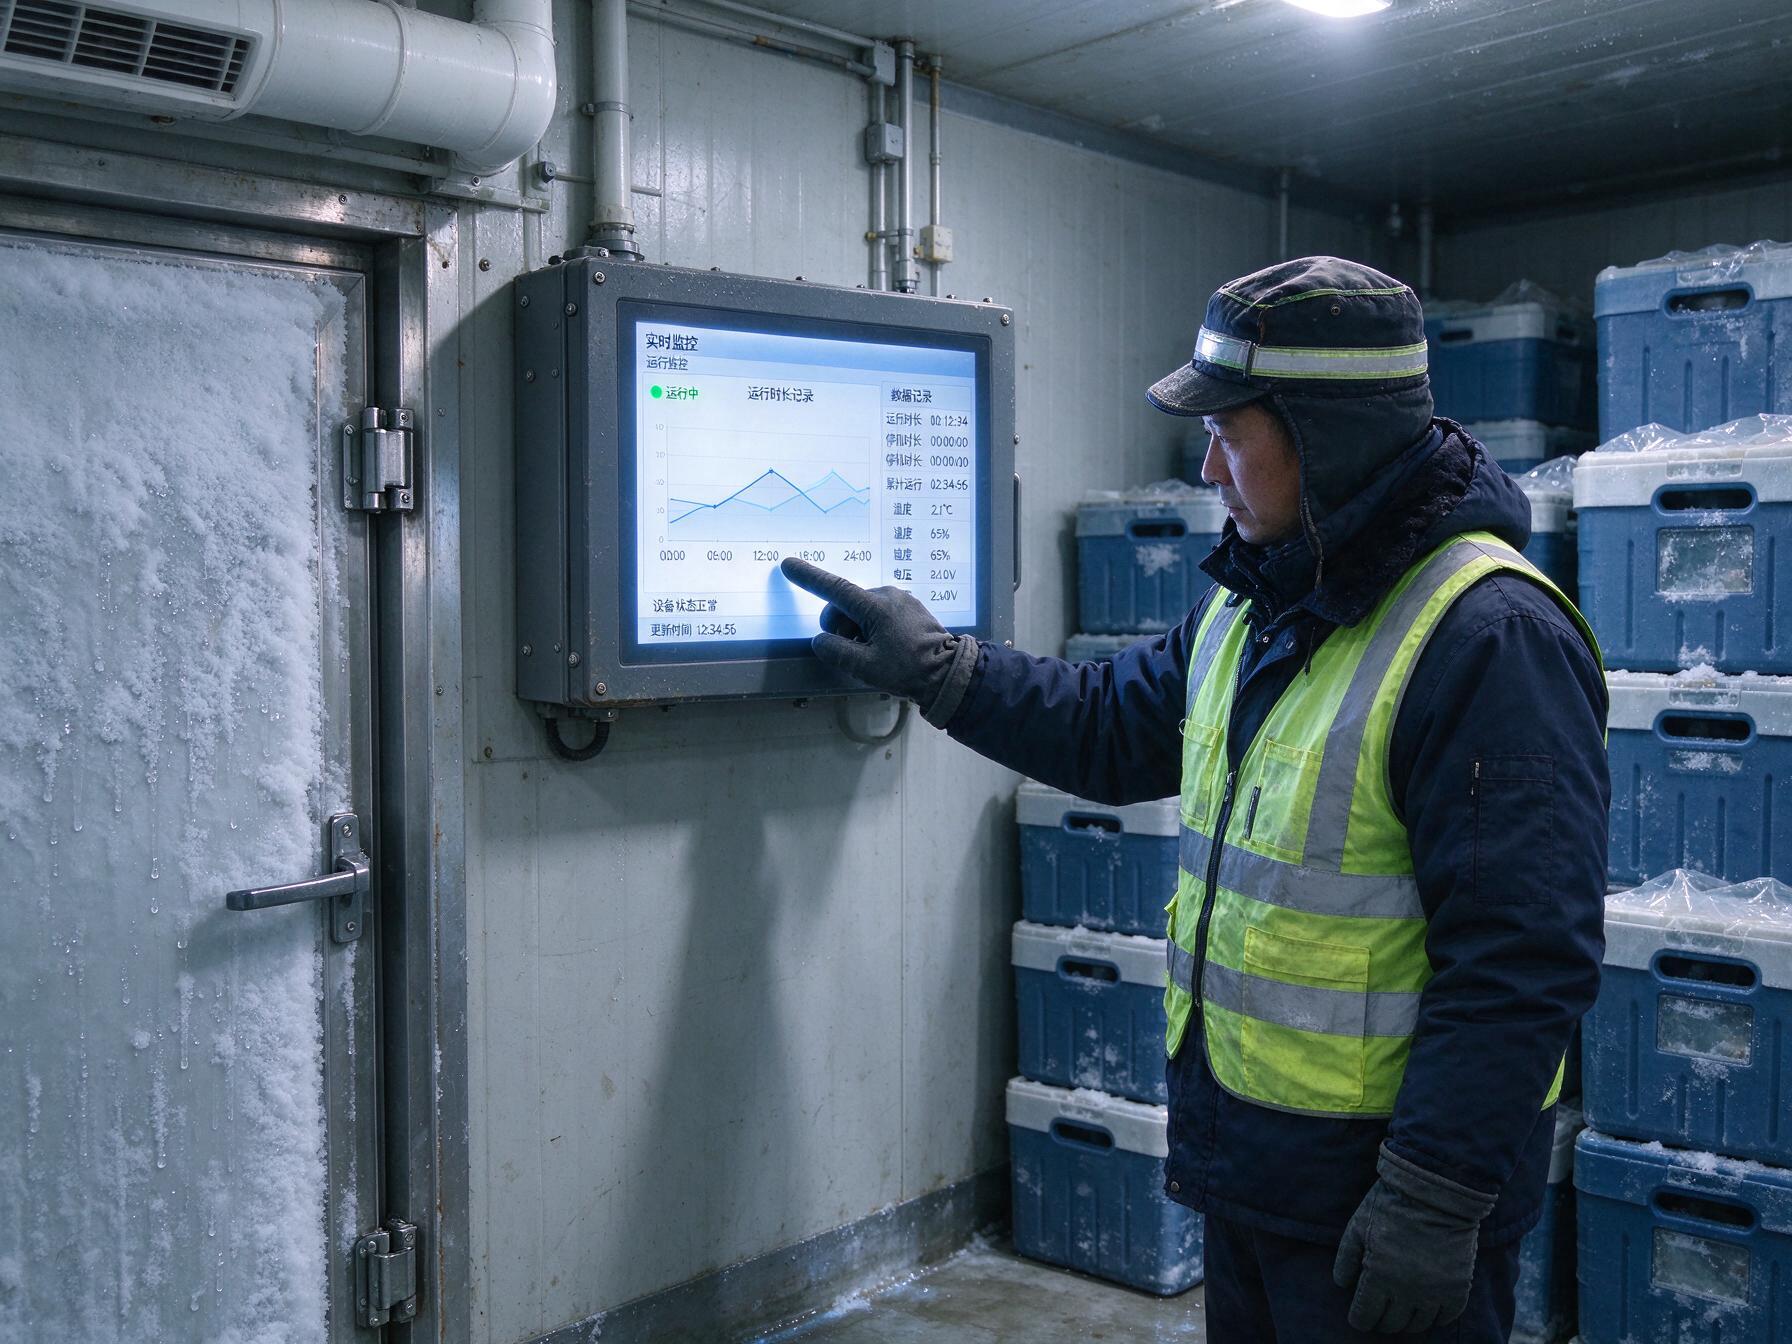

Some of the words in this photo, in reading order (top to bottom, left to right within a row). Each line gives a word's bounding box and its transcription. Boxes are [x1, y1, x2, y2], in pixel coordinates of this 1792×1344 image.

[646, 332, 699, 351] 实时监控
[666, 386, 699, 400] 运行中
[747, 386, 814, 402] 运行时长记录
[886, 412, 922, 426] 运行时长
[753, 550, 779, 561] 12:00
[843, 550, 872, 561] 24:00
